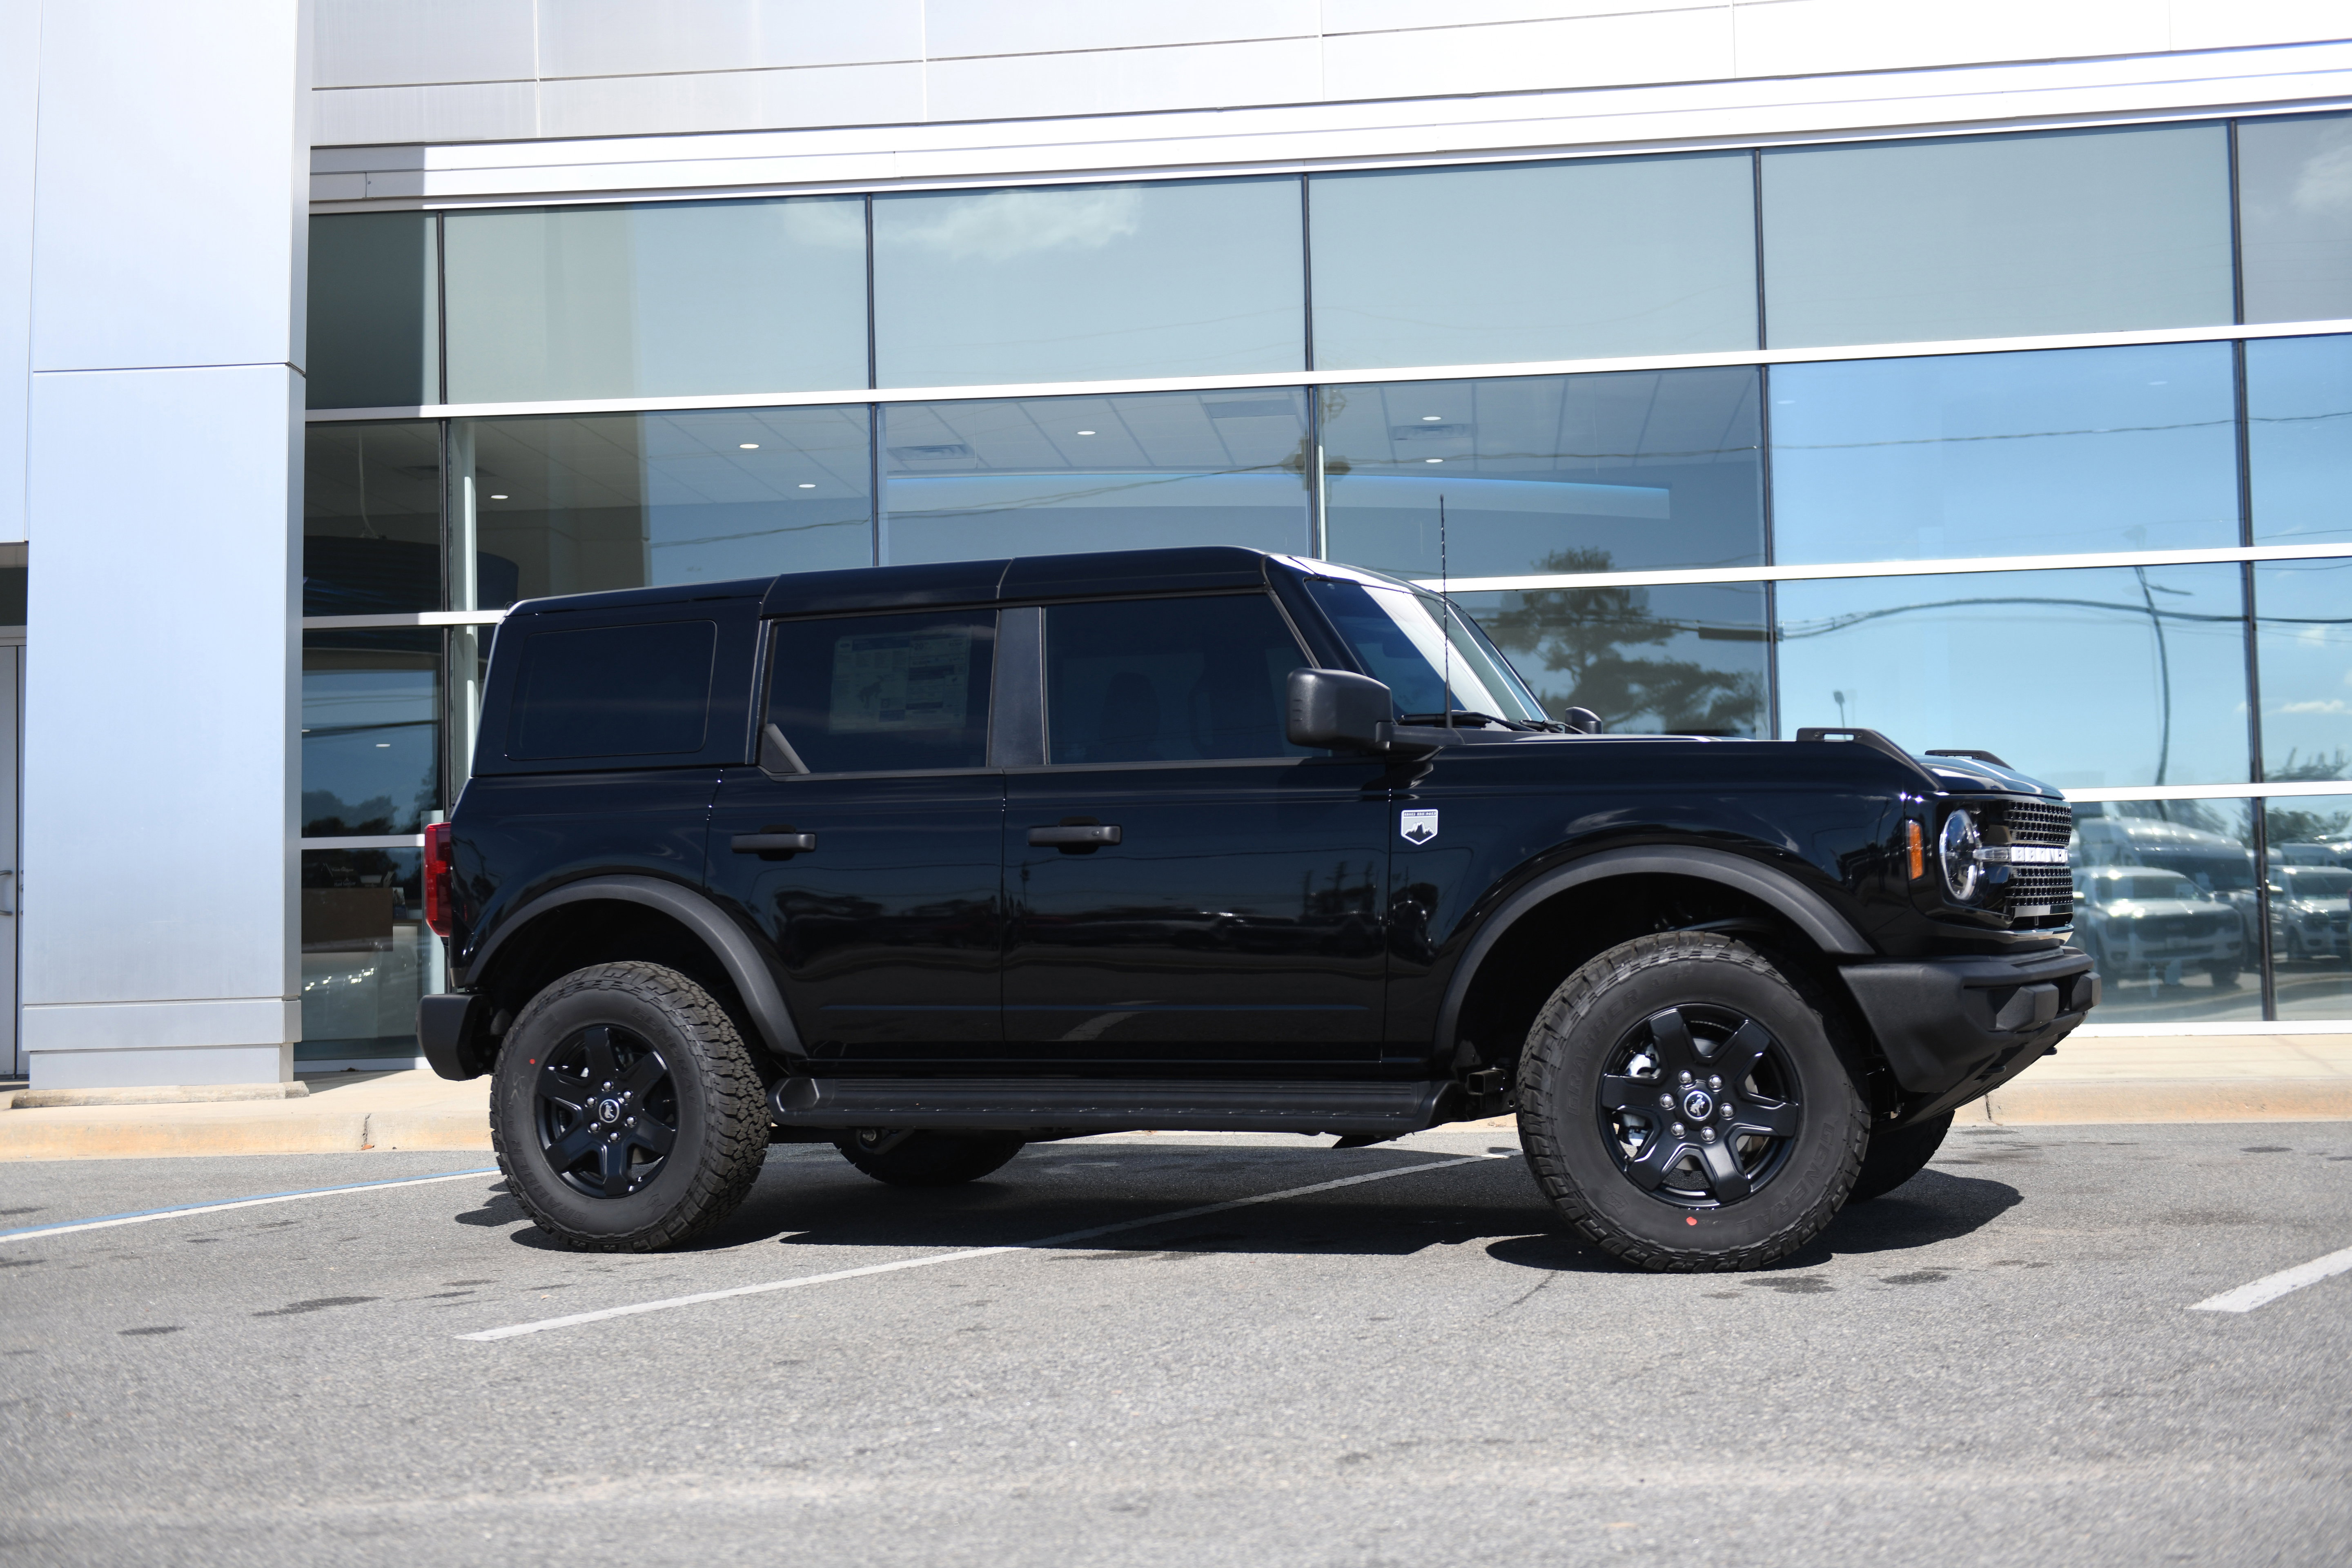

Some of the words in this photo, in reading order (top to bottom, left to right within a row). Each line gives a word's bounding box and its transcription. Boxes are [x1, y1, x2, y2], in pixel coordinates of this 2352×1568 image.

[632, 1007, 697, 1103] GENERAL
[1566, 989, 1638, 1116] GRABBER
[512, 1140, 588, 1224] GRABBER
[1736, 1122, 1836, 1235] GENERAL
